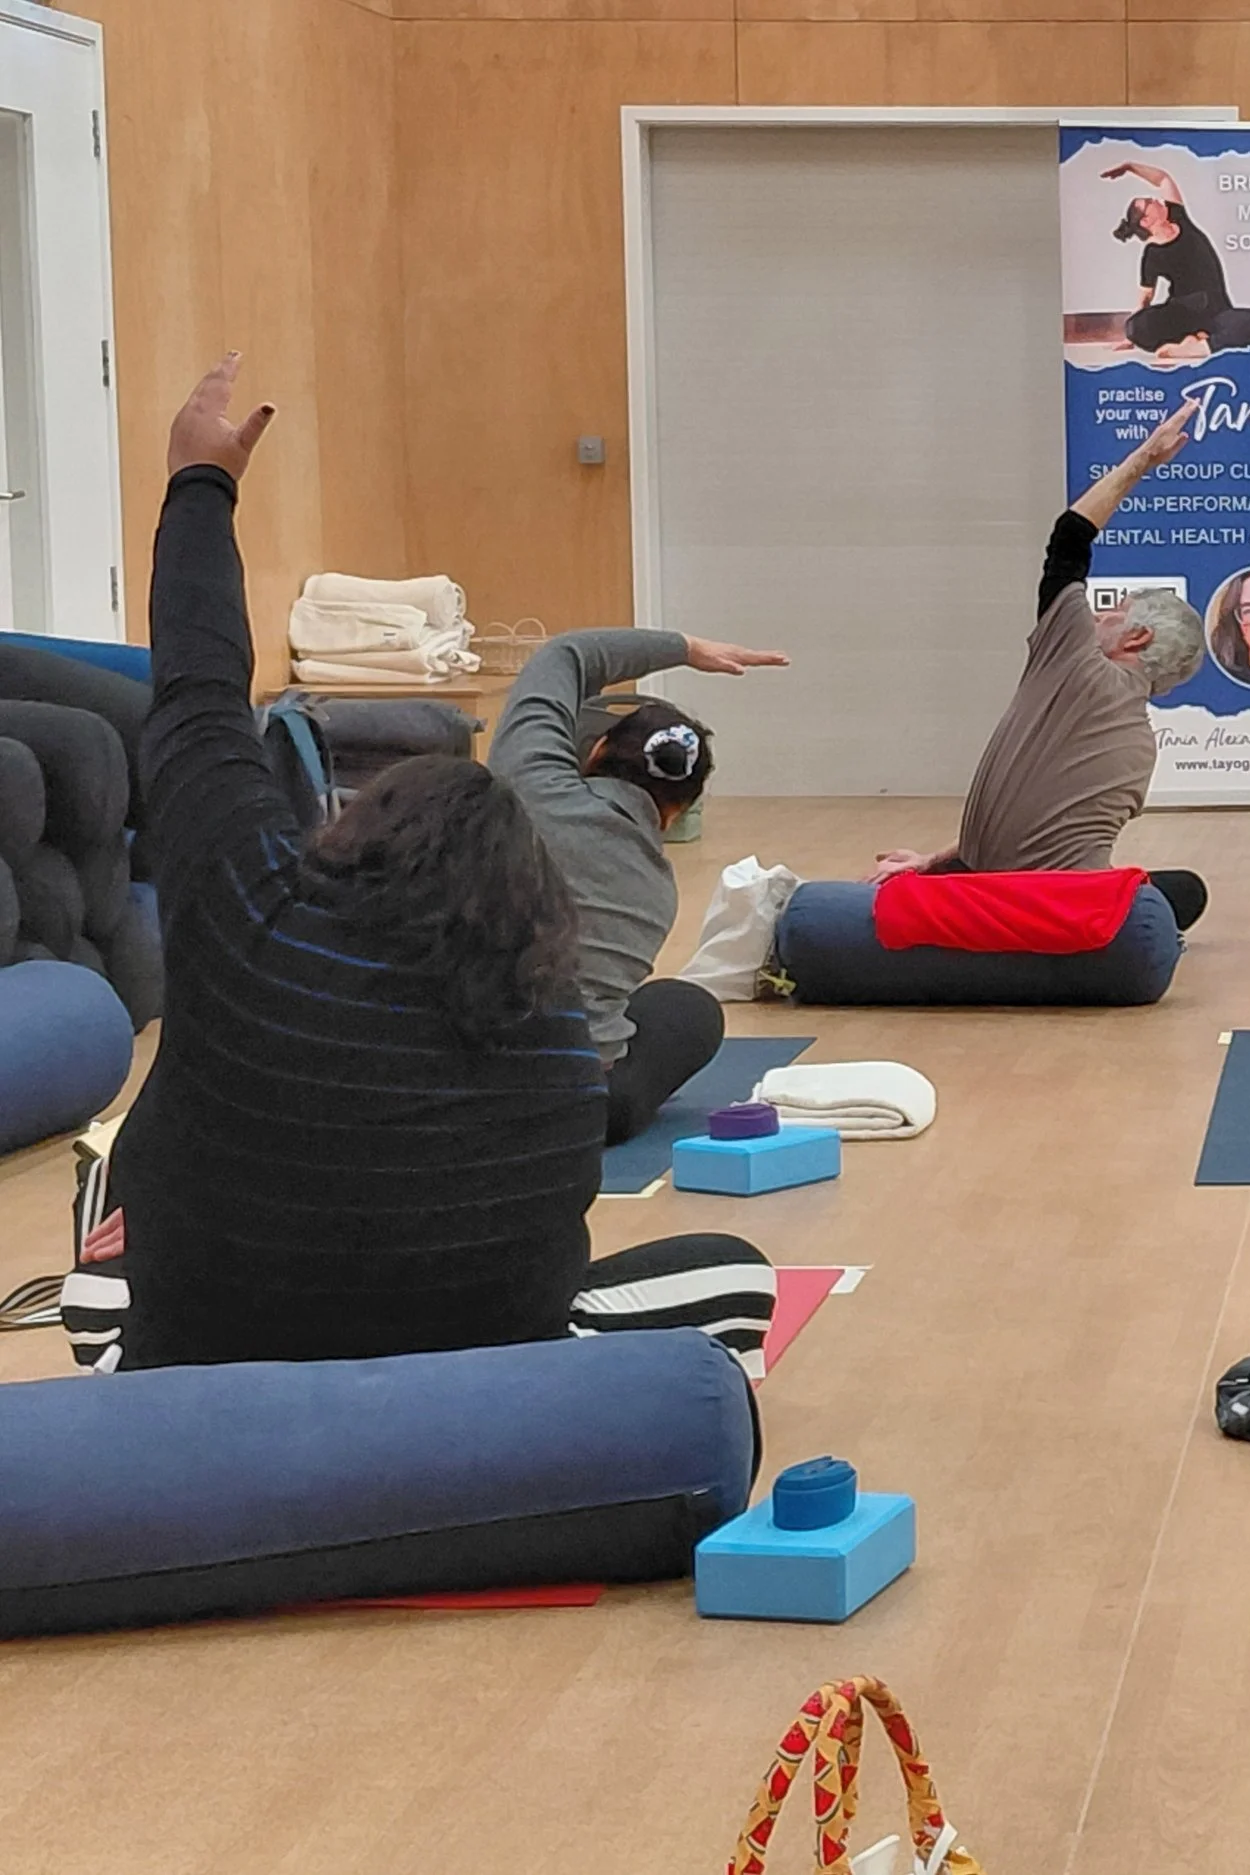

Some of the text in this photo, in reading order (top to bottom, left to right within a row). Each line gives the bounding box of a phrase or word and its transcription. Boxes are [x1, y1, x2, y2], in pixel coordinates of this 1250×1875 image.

[1098, 386, 1165, 405] practise
[1096, 408, 1168, 425] your way
[1115, 424, 1149, 440] with
[1155, 463, 1224, 480] GROUP
[1093, 529, 1165, 546] MENTAL
[1171, 528, 1245, 545] HEALTH
[1155, 727, 1199, 750] Tania
